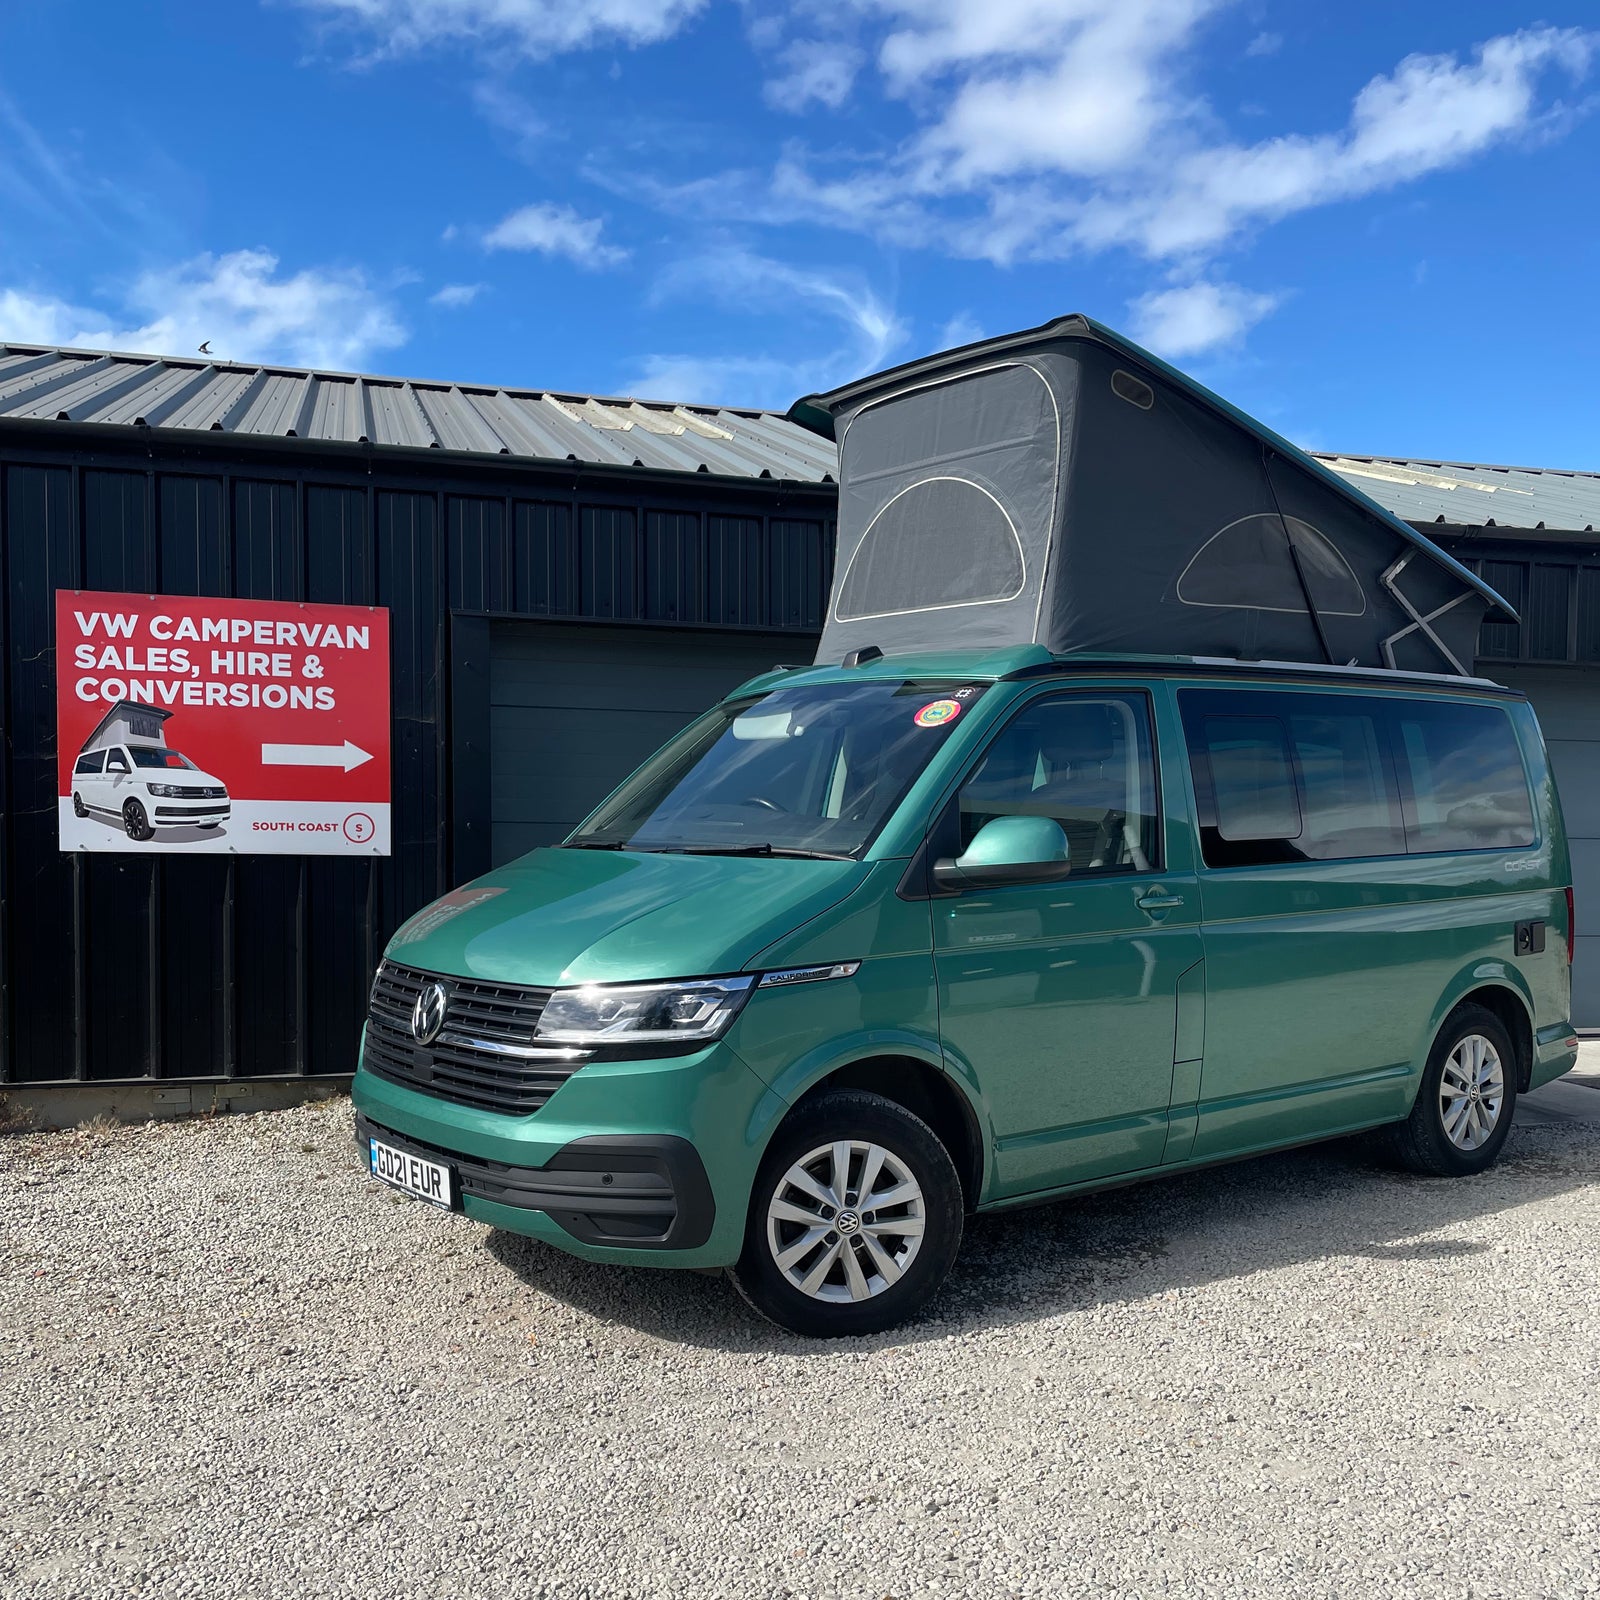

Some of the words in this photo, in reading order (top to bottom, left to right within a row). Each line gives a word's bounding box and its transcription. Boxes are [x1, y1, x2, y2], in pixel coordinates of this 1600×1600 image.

[74, 611, 139, 638] VW
[150, 615, 370, 650] CAMPERVAN
[74, 644, 200, 678] SALES,
[211, 650, 292, 677] HIRE
[302, 654, 325, 679] &
[75, 677, 335, 710] CONVERSIONS
[252, 821, 295, 832] SOUTH
[298, 822, 338, 833] COAST
[1505, 860, 1541, 872] COAST
[377, 1145, 408, 1185] GD21
[410, 1160, 442, 1199] EUR
